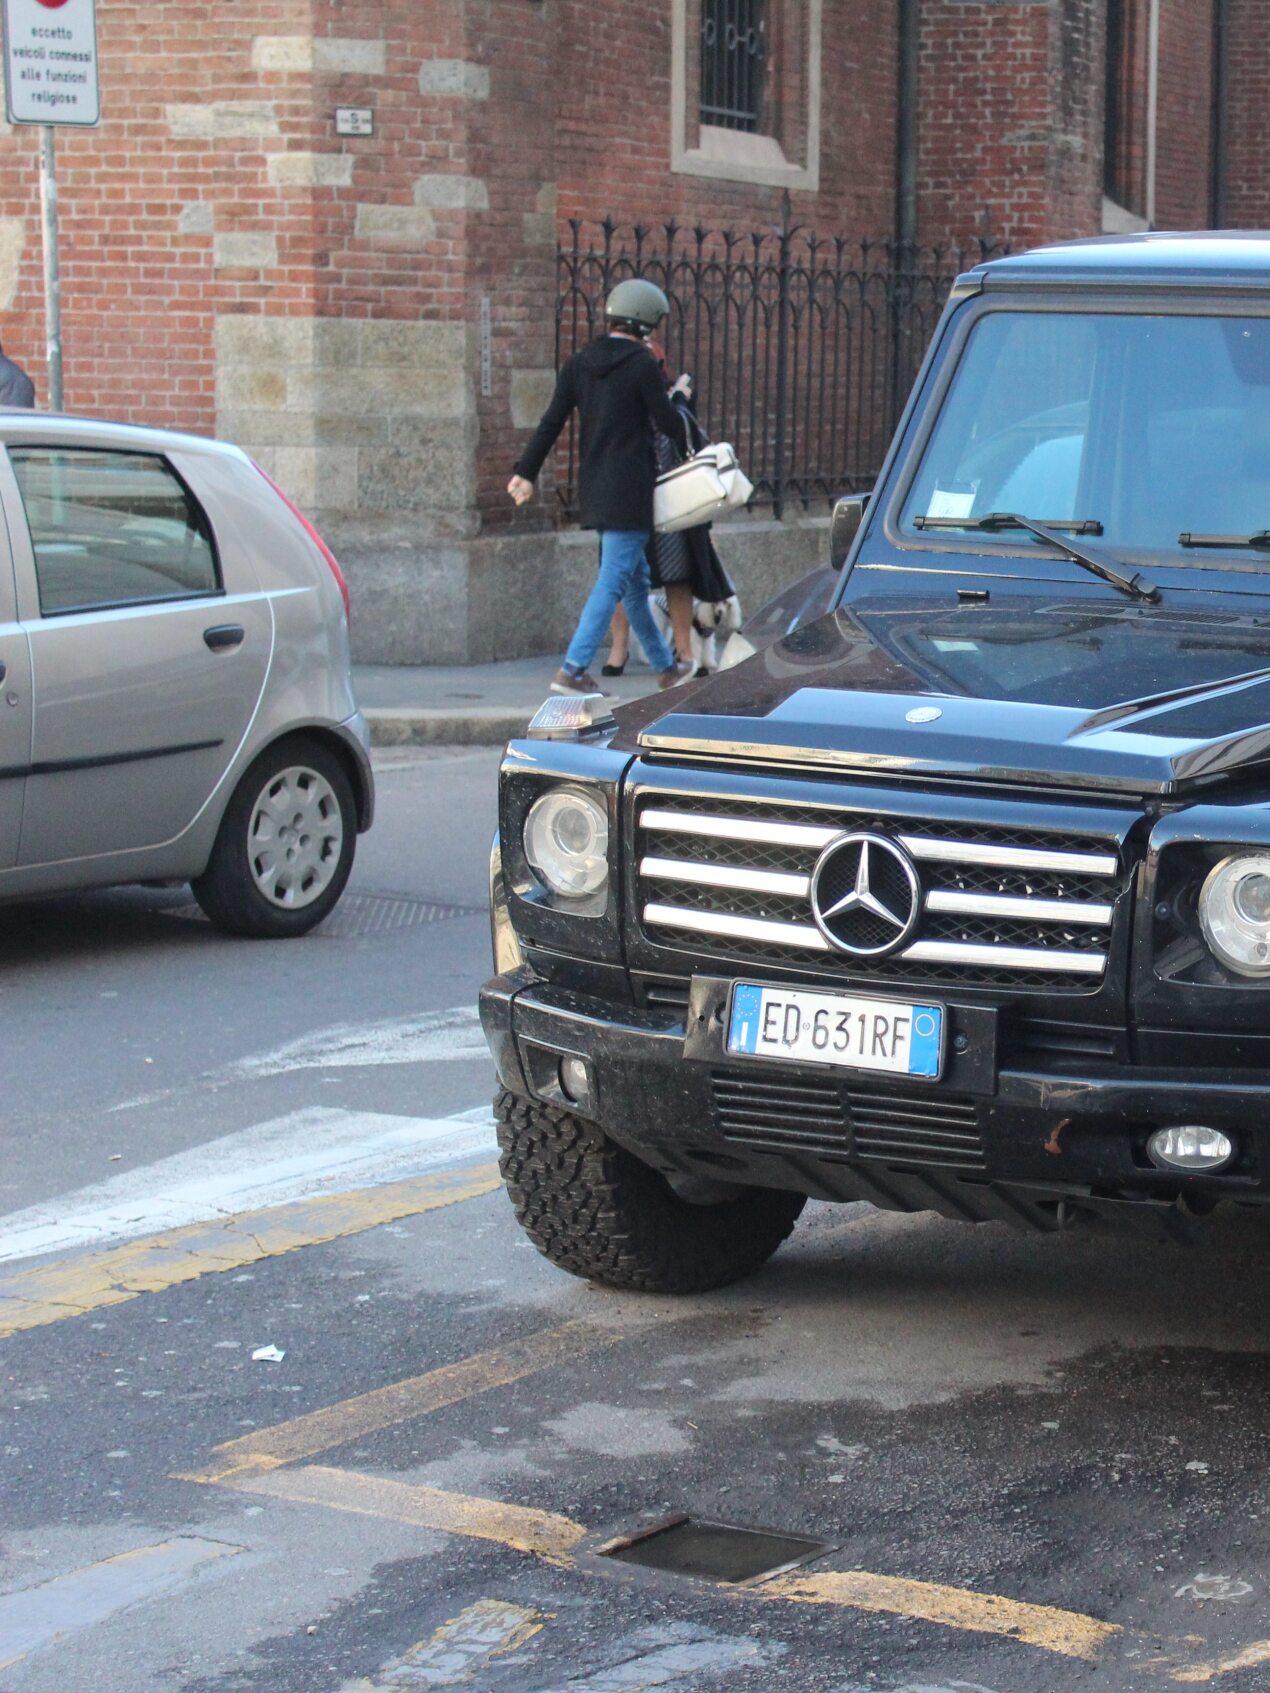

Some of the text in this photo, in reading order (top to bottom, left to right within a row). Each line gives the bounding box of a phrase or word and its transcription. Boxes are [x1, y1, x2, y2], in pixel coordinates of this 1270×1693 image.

[31, 27, 73, 40] eccetto
[12, 45, 92, 63] veicoli connessi
[21, 68, 87, 84] alle funzioni
[31, 90, 78, 107] religiose
